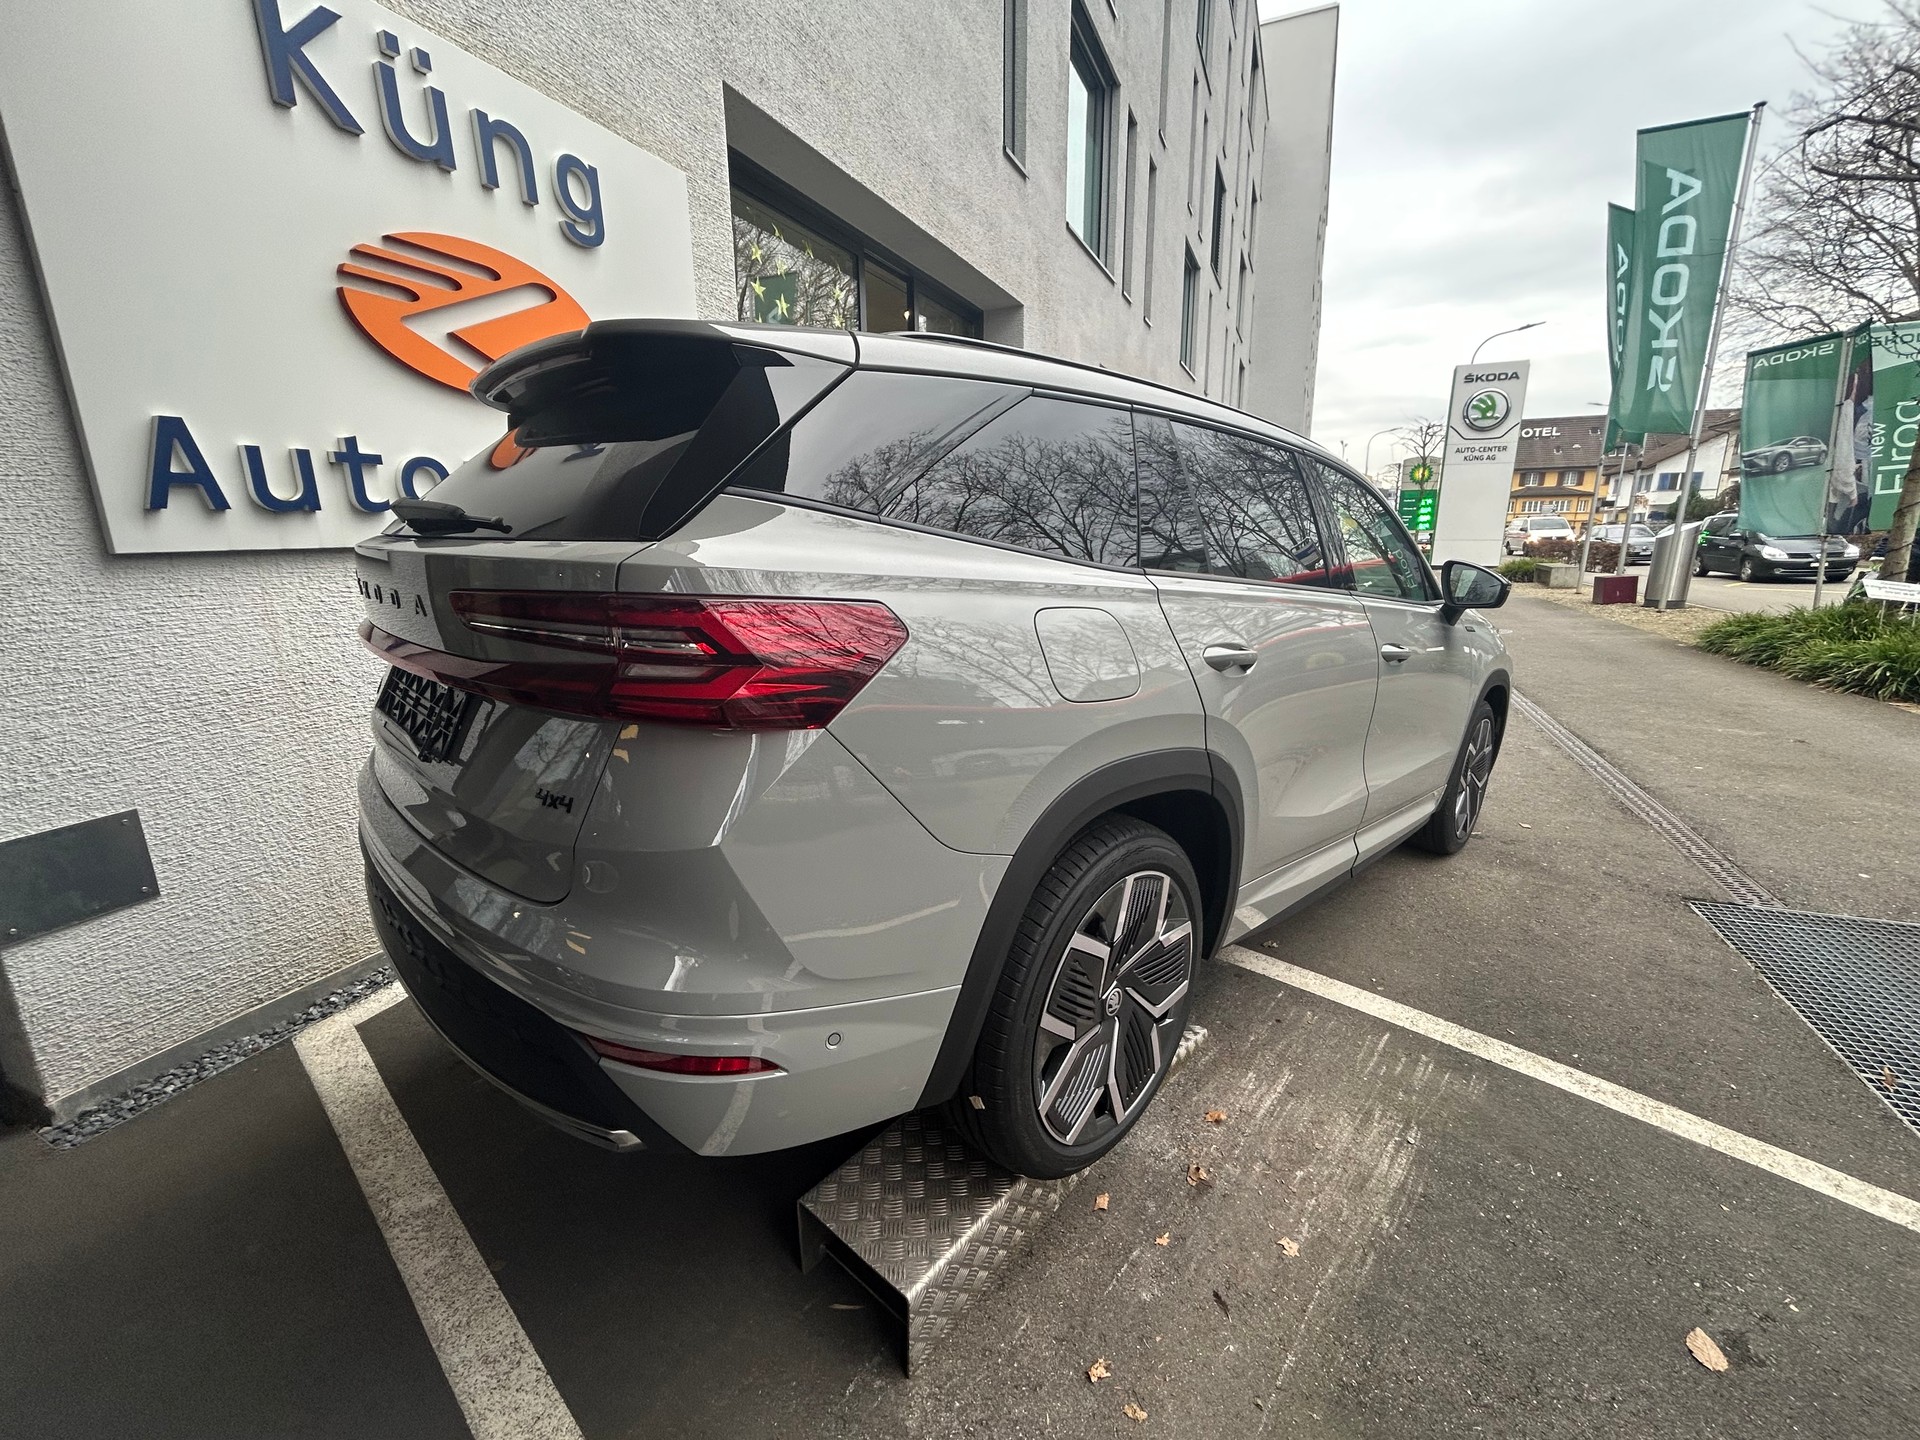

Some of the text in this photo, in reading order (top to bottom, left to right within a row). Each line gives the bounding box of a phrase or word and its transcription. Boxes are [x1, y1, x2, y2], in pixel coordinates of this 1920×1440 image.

[252, 0, 606, 249] Küng
[1463, 371, 1520, 384] ŠKODA
[1521, 426, 1561, 438] OTEL
[1870, 422, 1886, 458] New
[1455, 445, 1508, 454] AUTO-CENTER
[1463, 453, 1496, 461] KÜNG AG
[144, 414, 450, 513] Auto
[535, 788, 574, 814] 4x4
